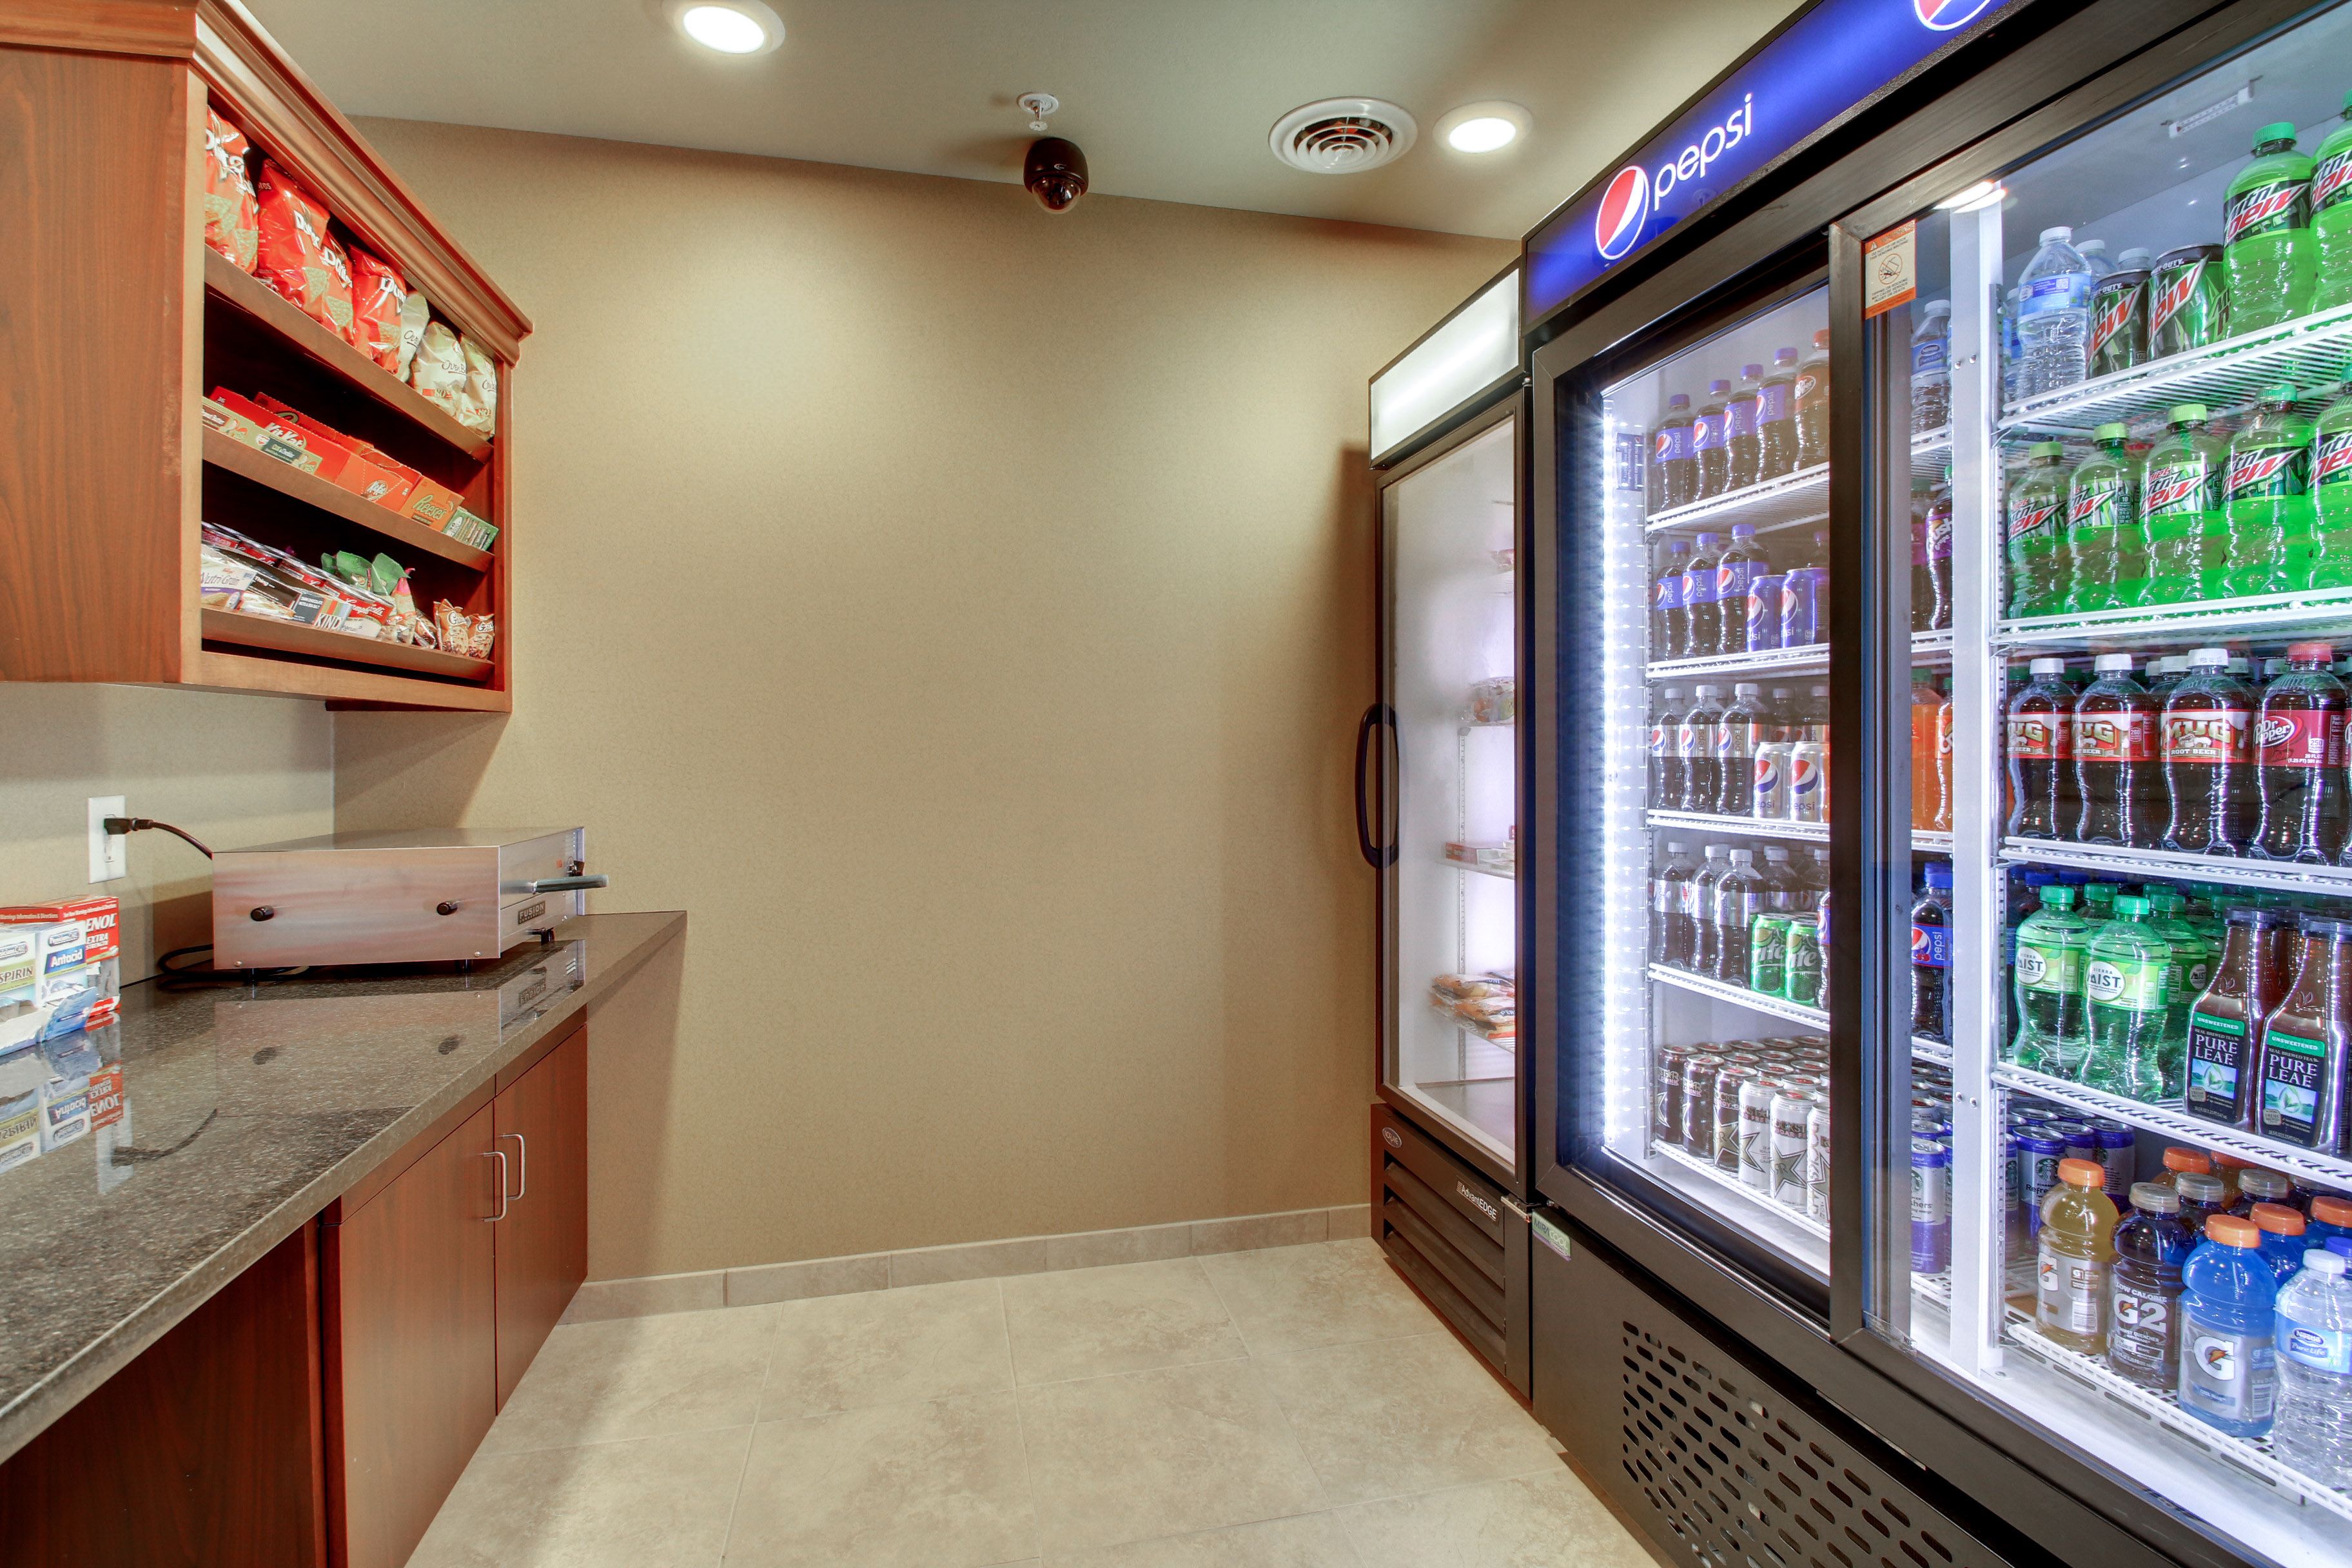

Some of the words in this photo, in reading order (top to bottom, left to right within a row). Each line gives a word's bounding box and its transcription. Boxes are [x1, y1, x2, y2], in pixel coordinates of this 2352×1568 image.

[1654, 93, 1752, 211] pepsi
[1673, 432, 1682, 454] pepsi
[1695, 574, 1703, 597] pepsi
[1736, 567, 1745, 591] pepsi
[314, 613, 342, 630] KIND
[2170, 721, 2231, 743] MUG
[2255, 723, 2291, 745] Pepper
[2262, 720, 2279, 731] Dr
[519, 903, 545, 919] FUSION
[86, 933, 109, 945] EXTRA
[1932, 932, 1945, 961] pepsi
[52, 948, 83, 968] Antacid
[2197, 1017, 2239, 1030] UNSWEETENED
[2195, 1034, 2238, 1054] PURE
[2271, 1035, 2318, 1050] UNSWEETENED
[2195, 1046, 2233, 1065] LEAF
[2269, 1054, 2318, 1076] PURE
[2268, 1066, 2312, 1088] LEAF
[1461, 1185, 1497, 1219] AdvantEDGE
[2037, 1251, 2058, 1291] G
[2113, 1293, 2167, 1333] G2
[2193, 1335, 2235, 1380] G
